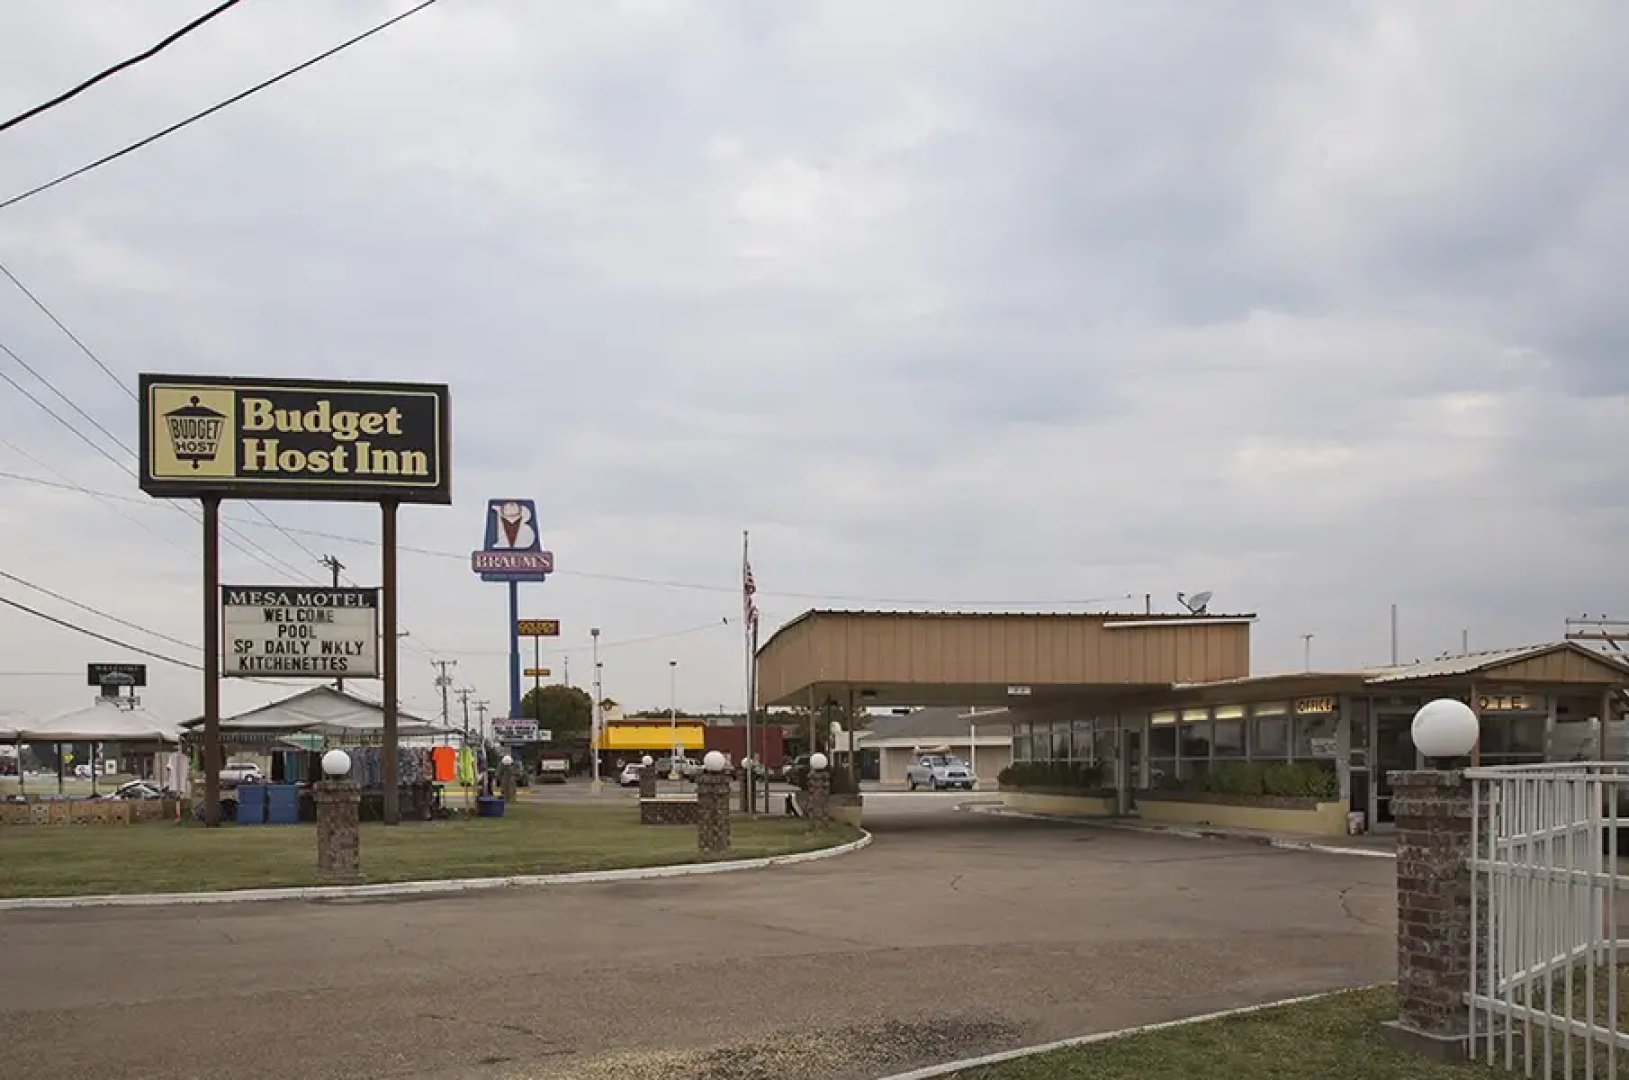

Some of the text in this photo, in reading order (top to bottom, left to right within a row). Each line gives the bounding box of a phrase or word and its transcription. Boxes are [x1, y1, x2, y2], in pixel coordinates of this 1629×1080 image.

[242, 397, 403, 441] Budget
[170, 418, 221, 440] BUDGET
[176, 442, 216, 453] HOST
[242, 438, 429, 476] Host Inn
[229, 591, 370, 607] MESA MOTEL
[263, 608, 334, 624] WELCOME
[278, 624, 317, 640] POOL
[233, 638, 364, 656] SP DAILY WKLY
[238, 656, 349, 671] KITCHENETTES
[1296, 698, 1331, 712] OFFICE
